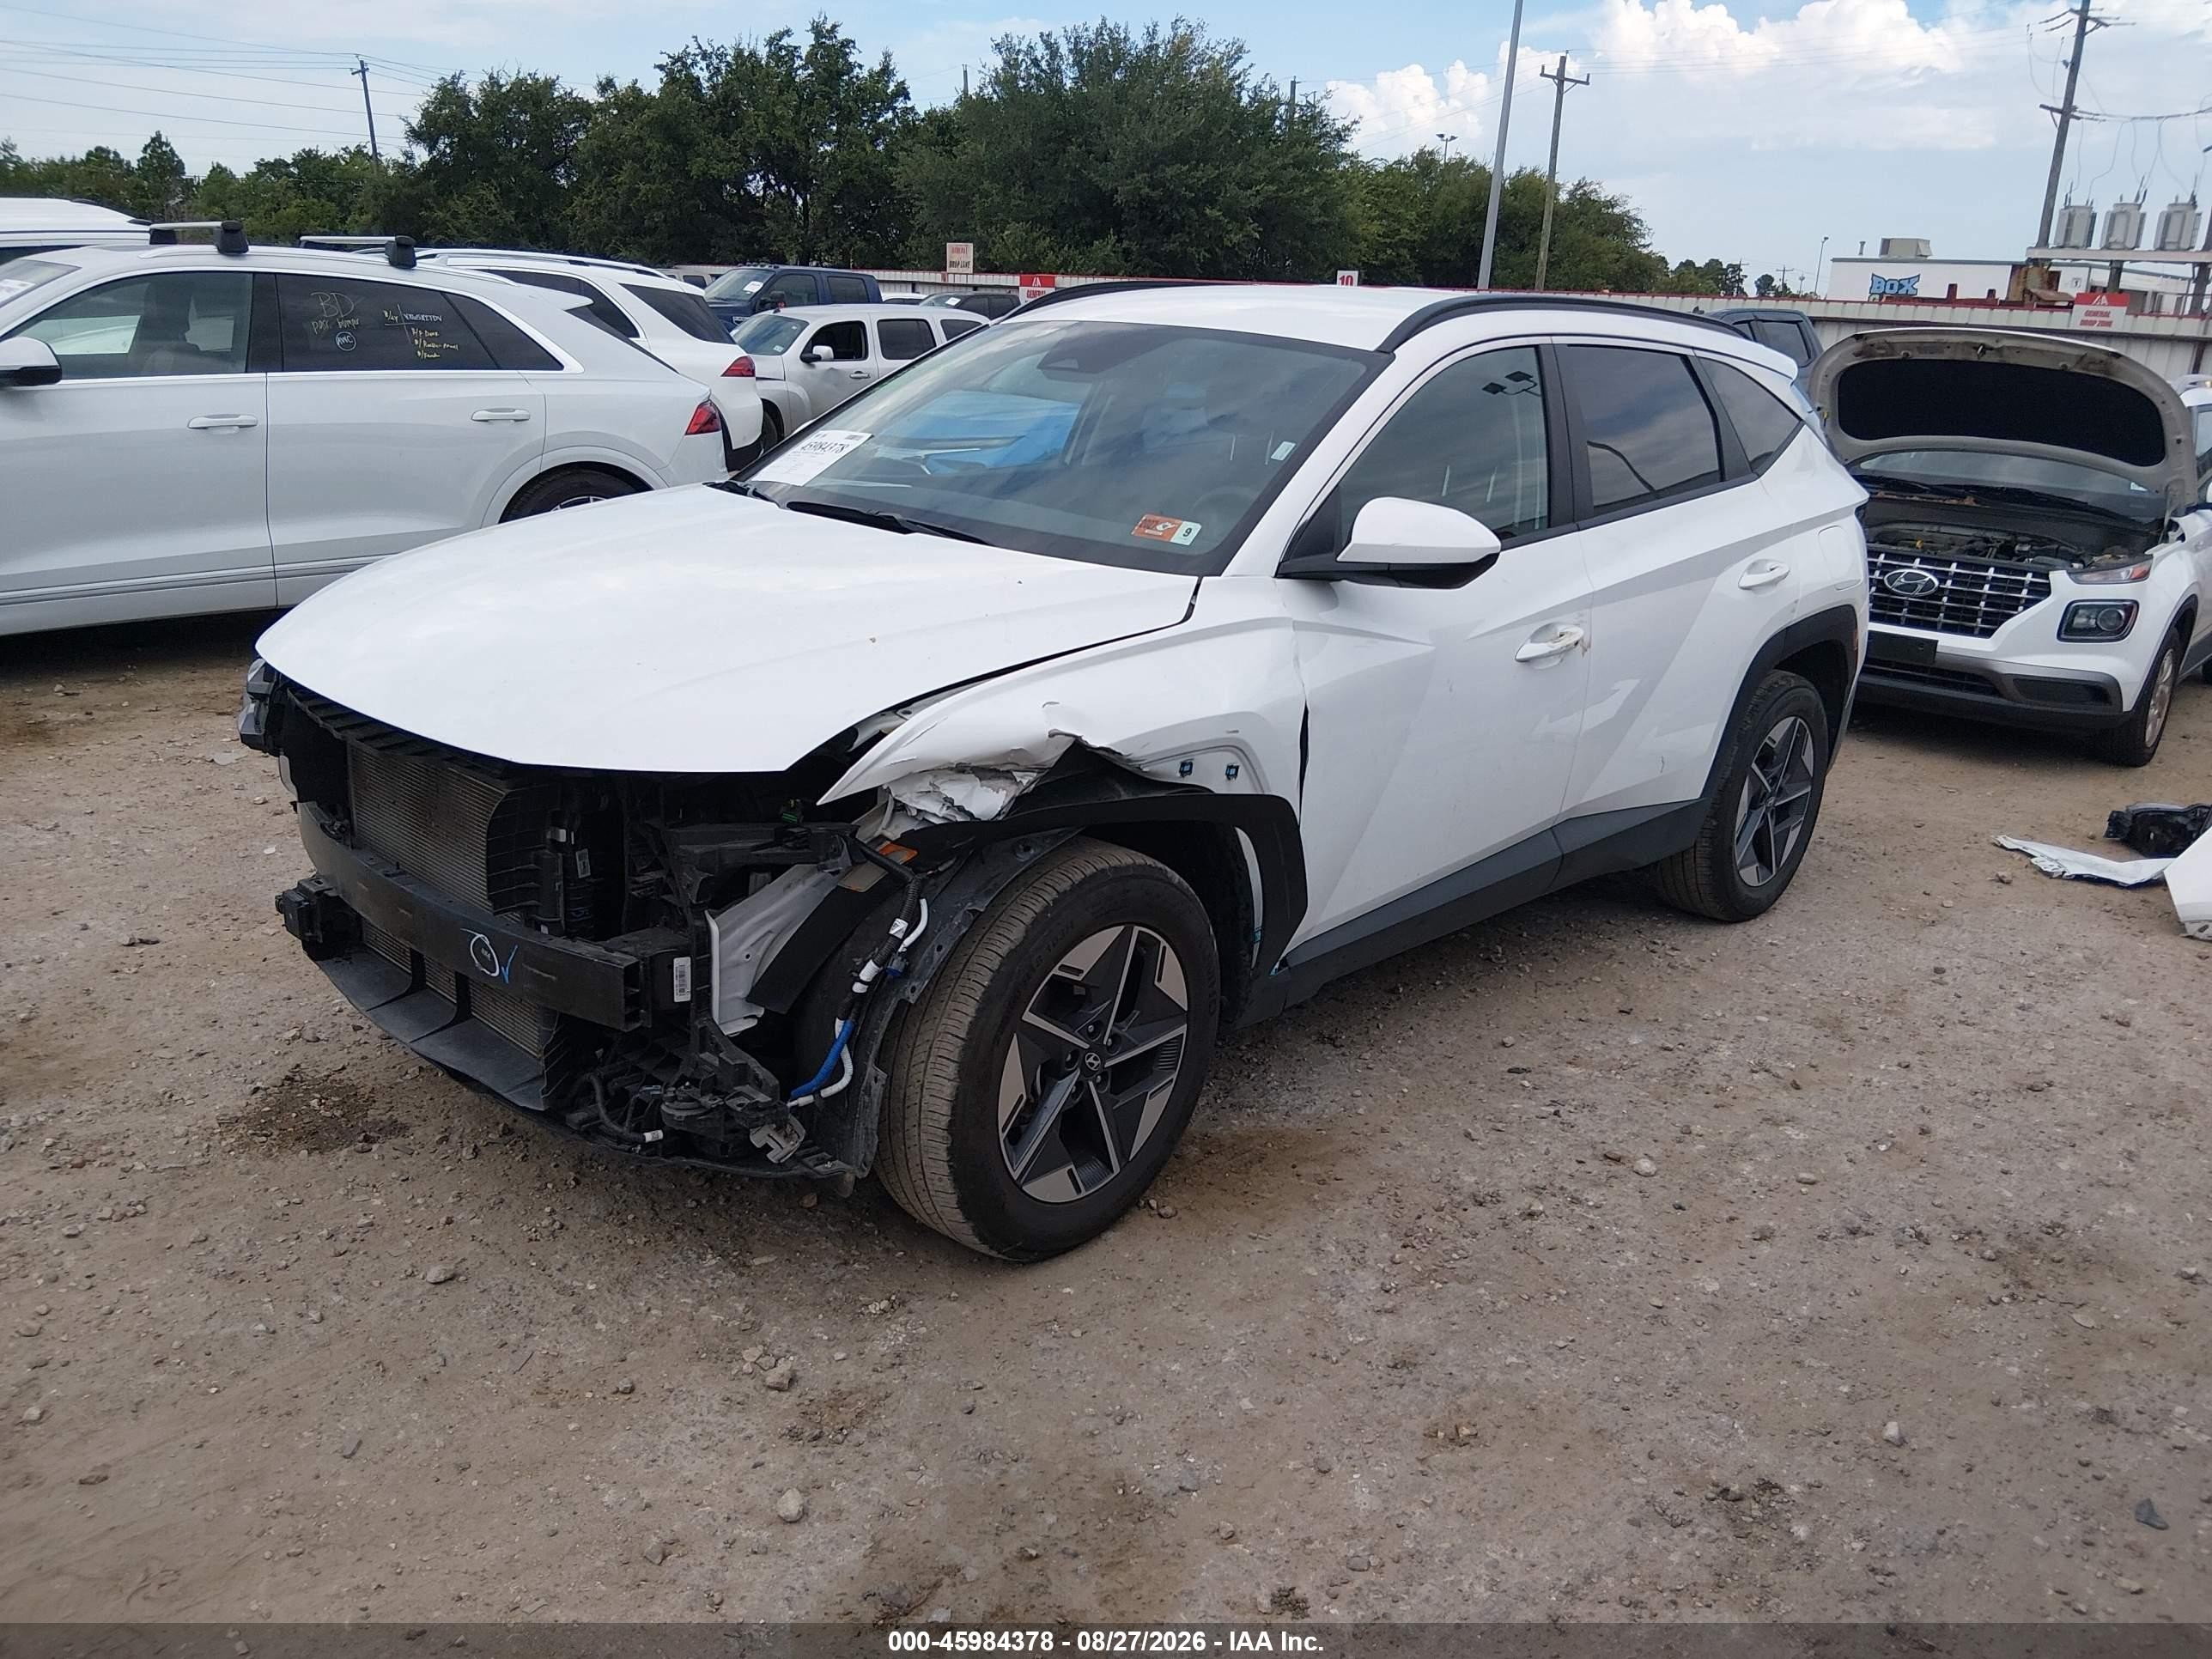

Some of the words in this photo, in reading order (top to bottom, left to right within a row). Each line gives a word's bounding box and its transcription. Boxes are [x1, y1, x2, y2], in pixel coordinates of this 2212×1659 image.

[1339, 274, 1354, 287] 10
[1869, 272, 1921, 296] BOX
[1182, 527, 1193, 537] 9
